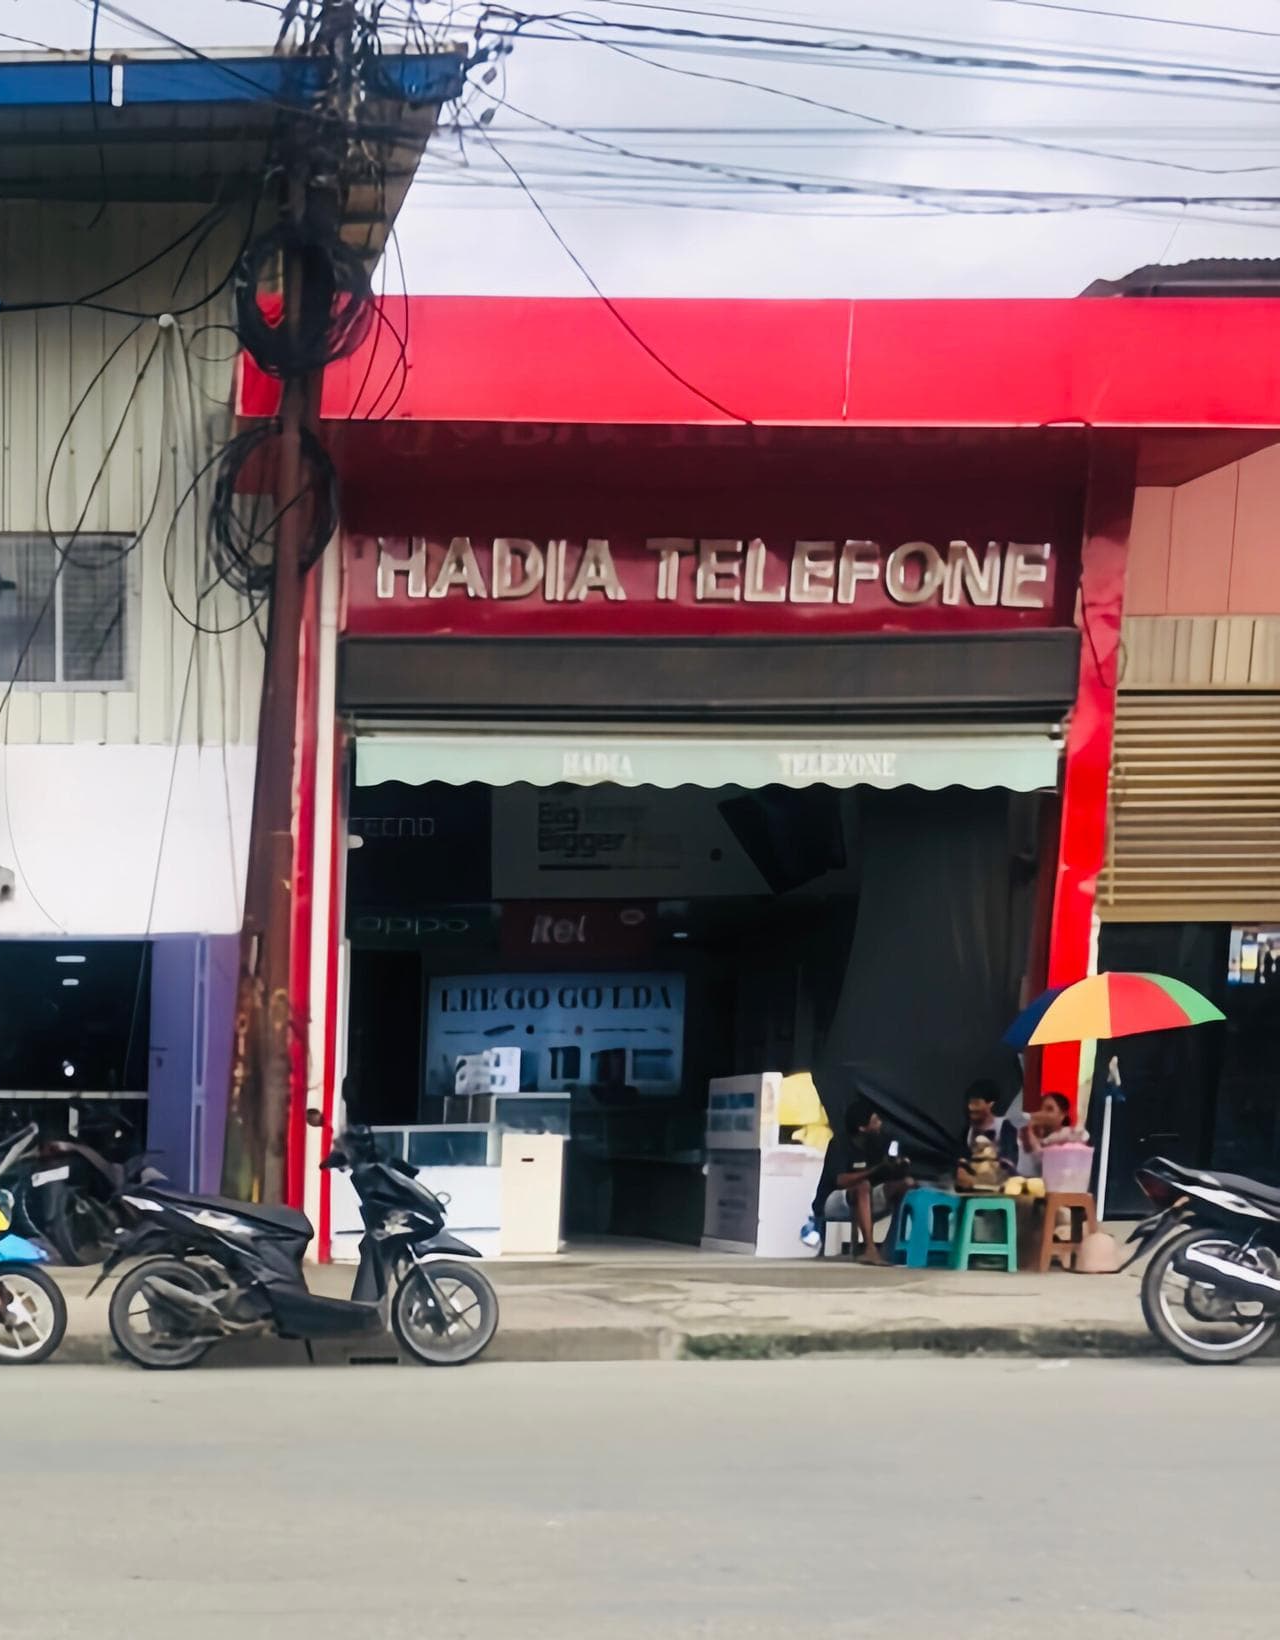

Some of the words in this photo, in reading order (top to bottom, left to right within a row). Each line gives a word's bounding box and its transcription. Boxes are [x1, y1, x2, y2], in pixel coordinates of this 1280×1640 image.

[376, 536, 627, 602] HADIA
[646, 536, 1052, 610] TELEFONE
[561, 752, 634, 779] HADIA
[777, 751, 897, 778] TELEFONE
